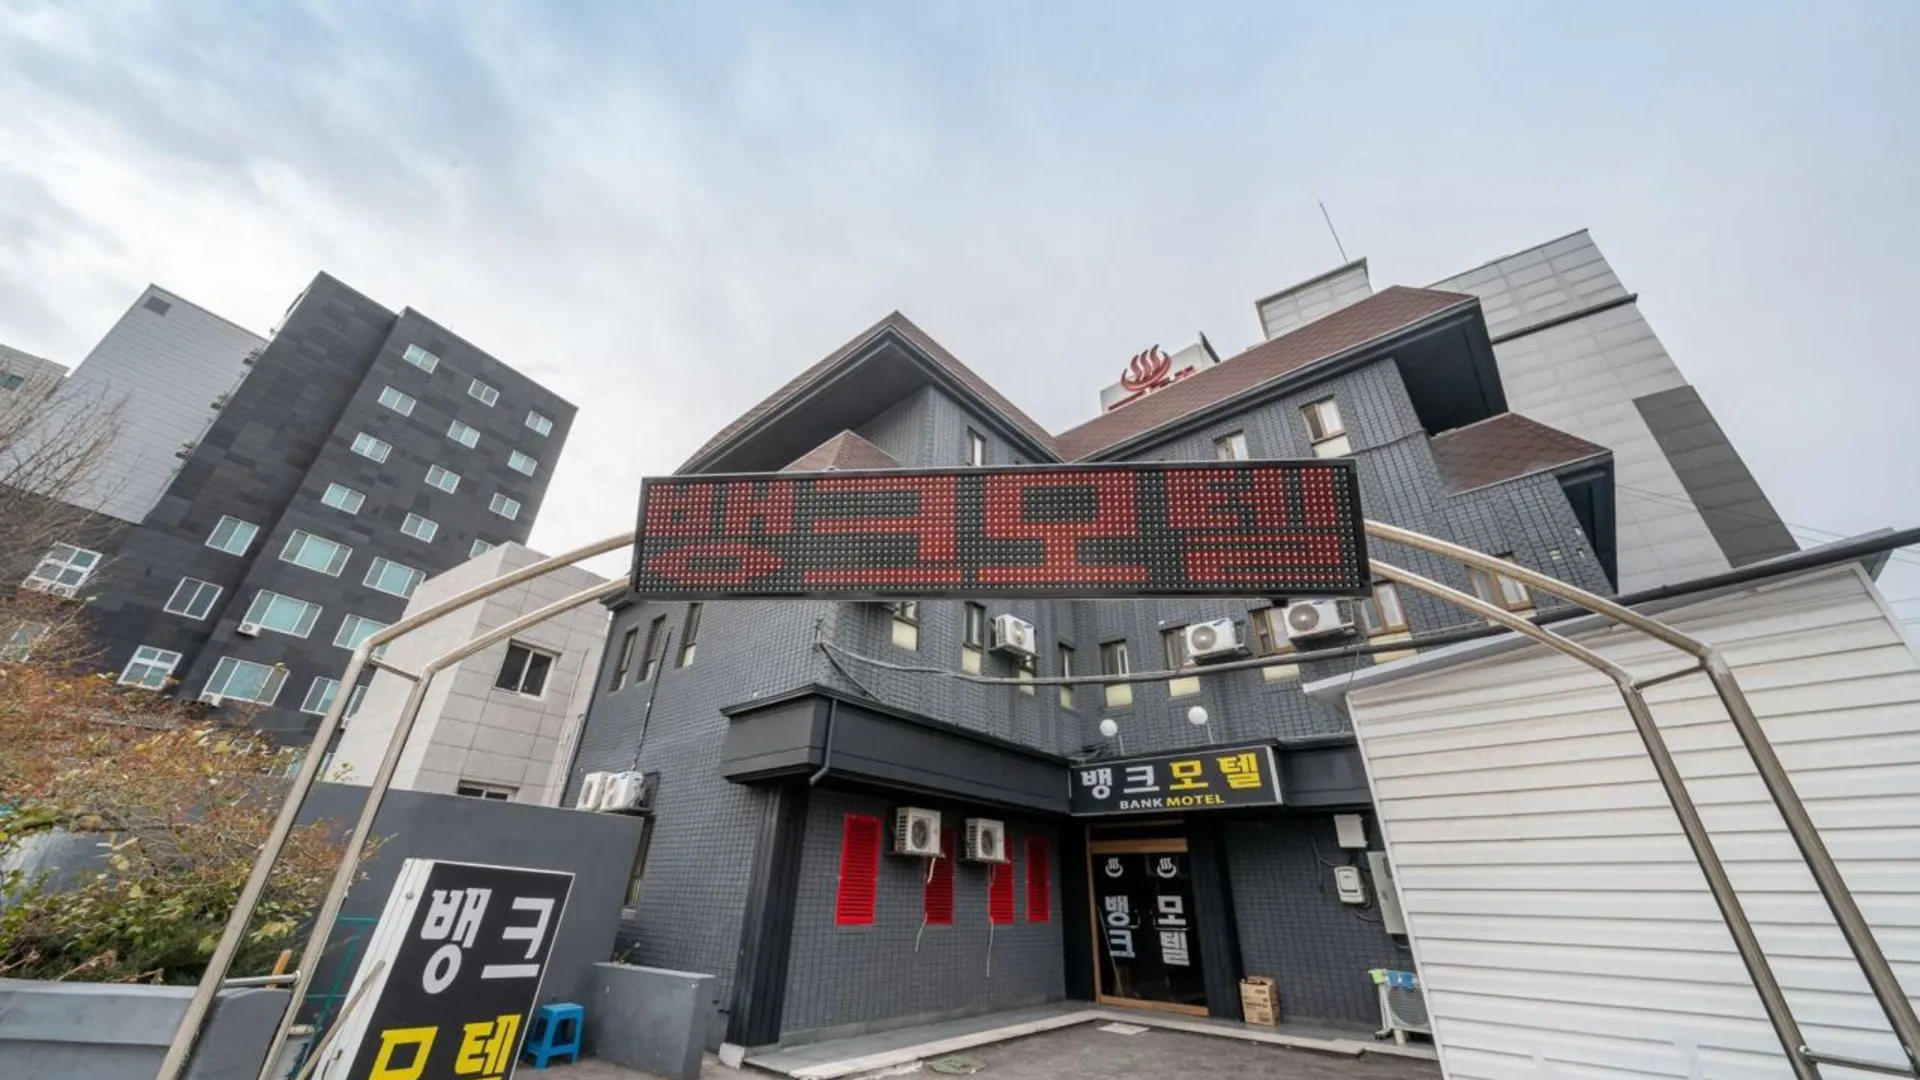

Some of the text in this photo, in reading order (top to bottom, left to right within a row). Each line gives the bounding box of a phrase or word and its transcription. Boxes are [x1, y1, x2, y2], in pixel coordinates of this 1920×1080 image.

[1120, 794, 1224, 810] BANK MOTEL
[420, 887, 555, 994] 뱅크
[1105, 895, 1135, 958] 뱅크
[1157, 895, 1190, 966] 모텔
